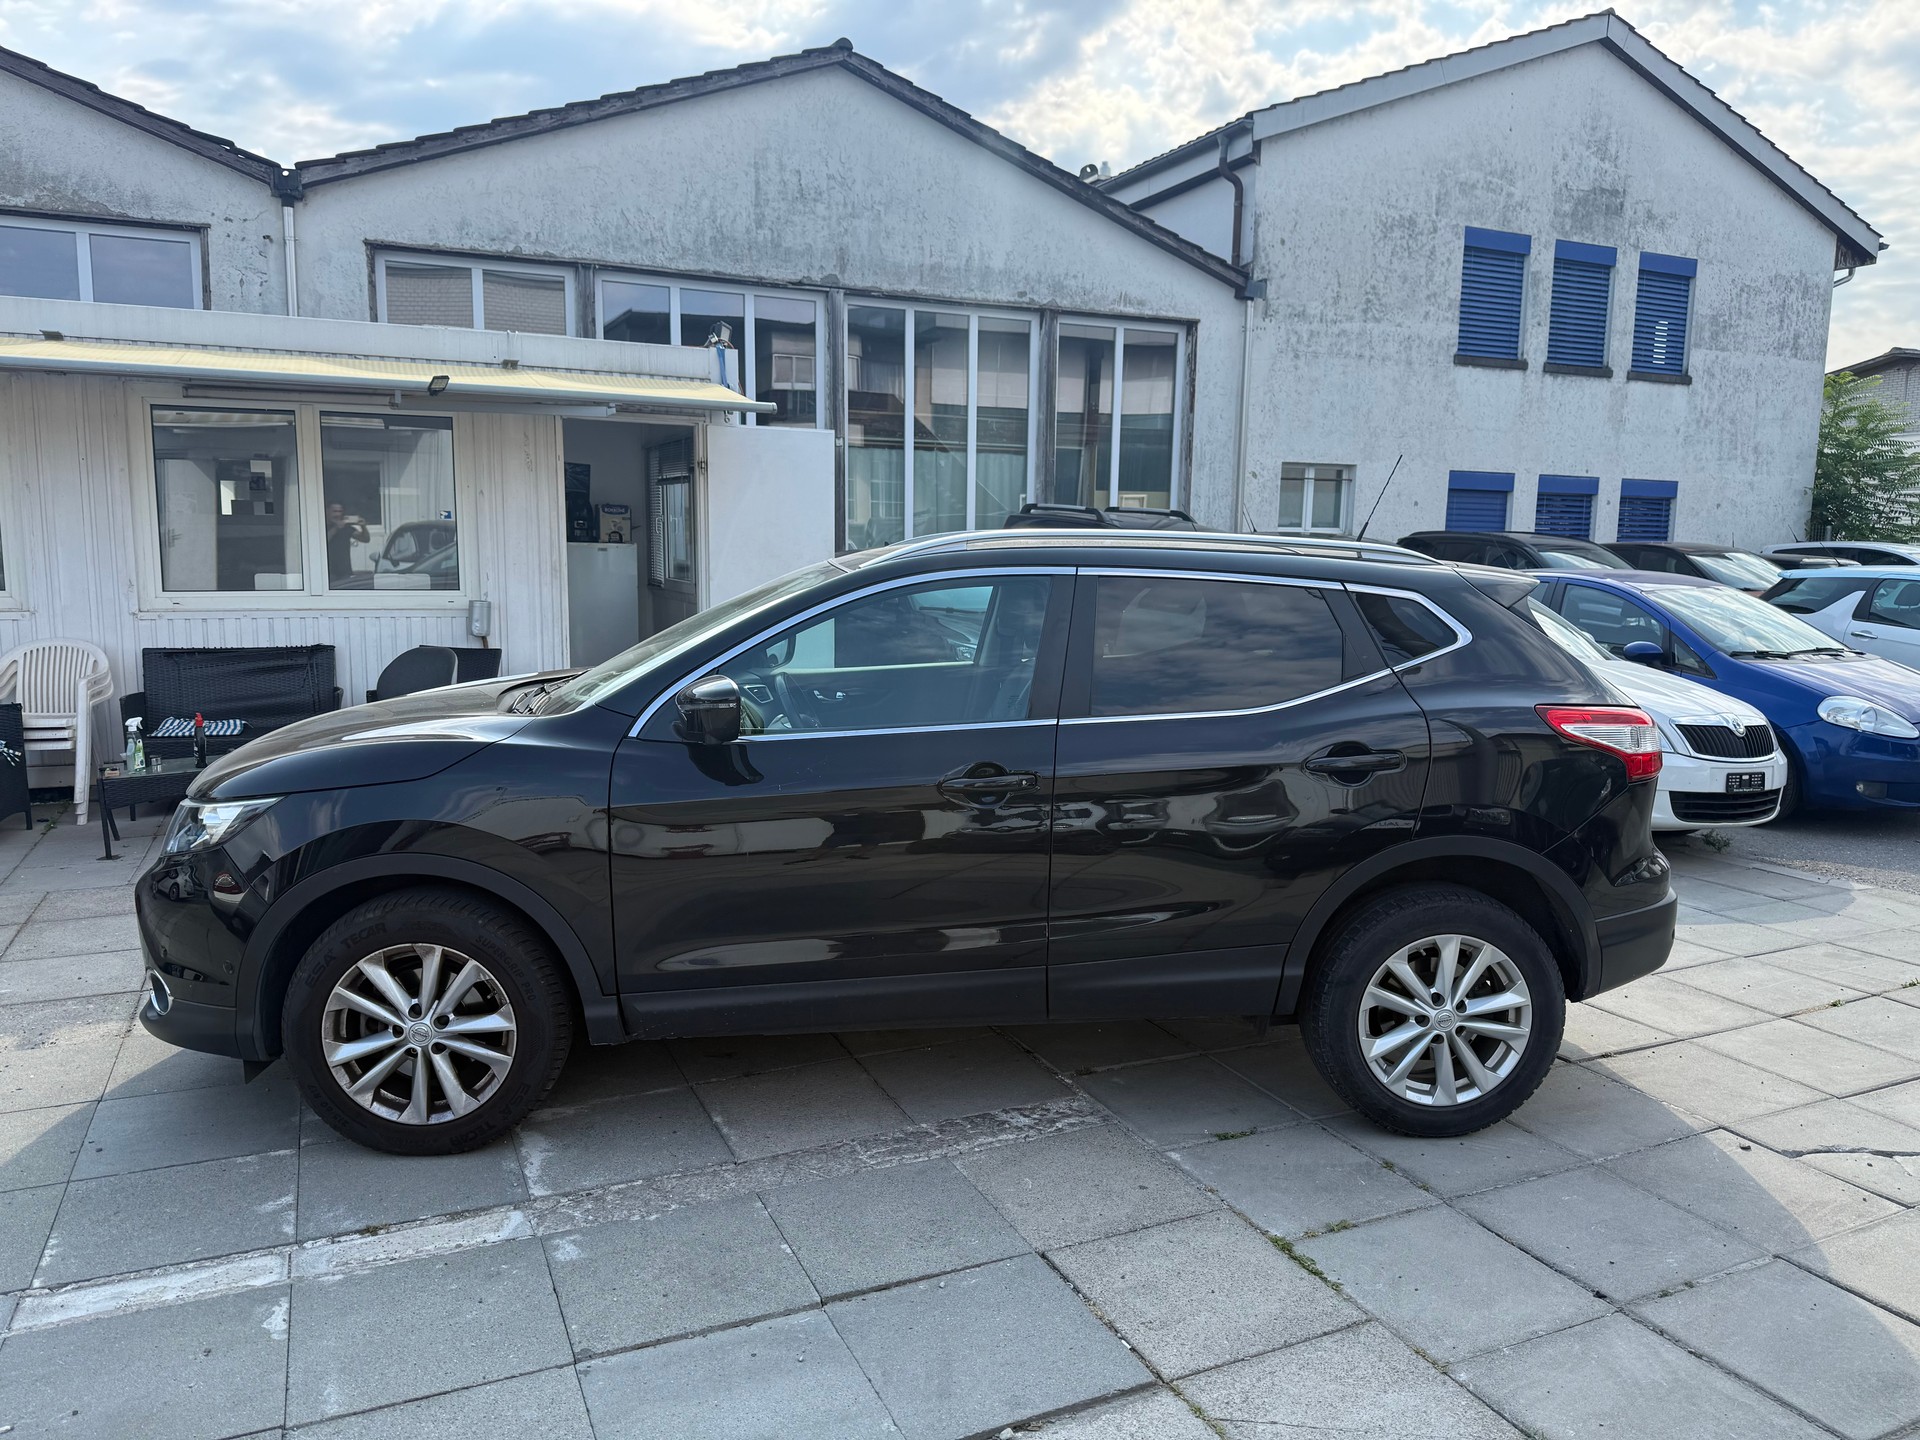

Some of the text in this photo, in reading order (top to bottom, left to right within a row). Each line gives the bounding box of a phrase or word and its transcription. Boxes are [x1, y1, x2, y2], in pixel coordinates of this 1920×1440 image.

[340, 922, 387, 949] TECAR
[474, 934, 537, 1002] SUPERGRIP PRO
[448, 1120, 496, 1147] TECAR
